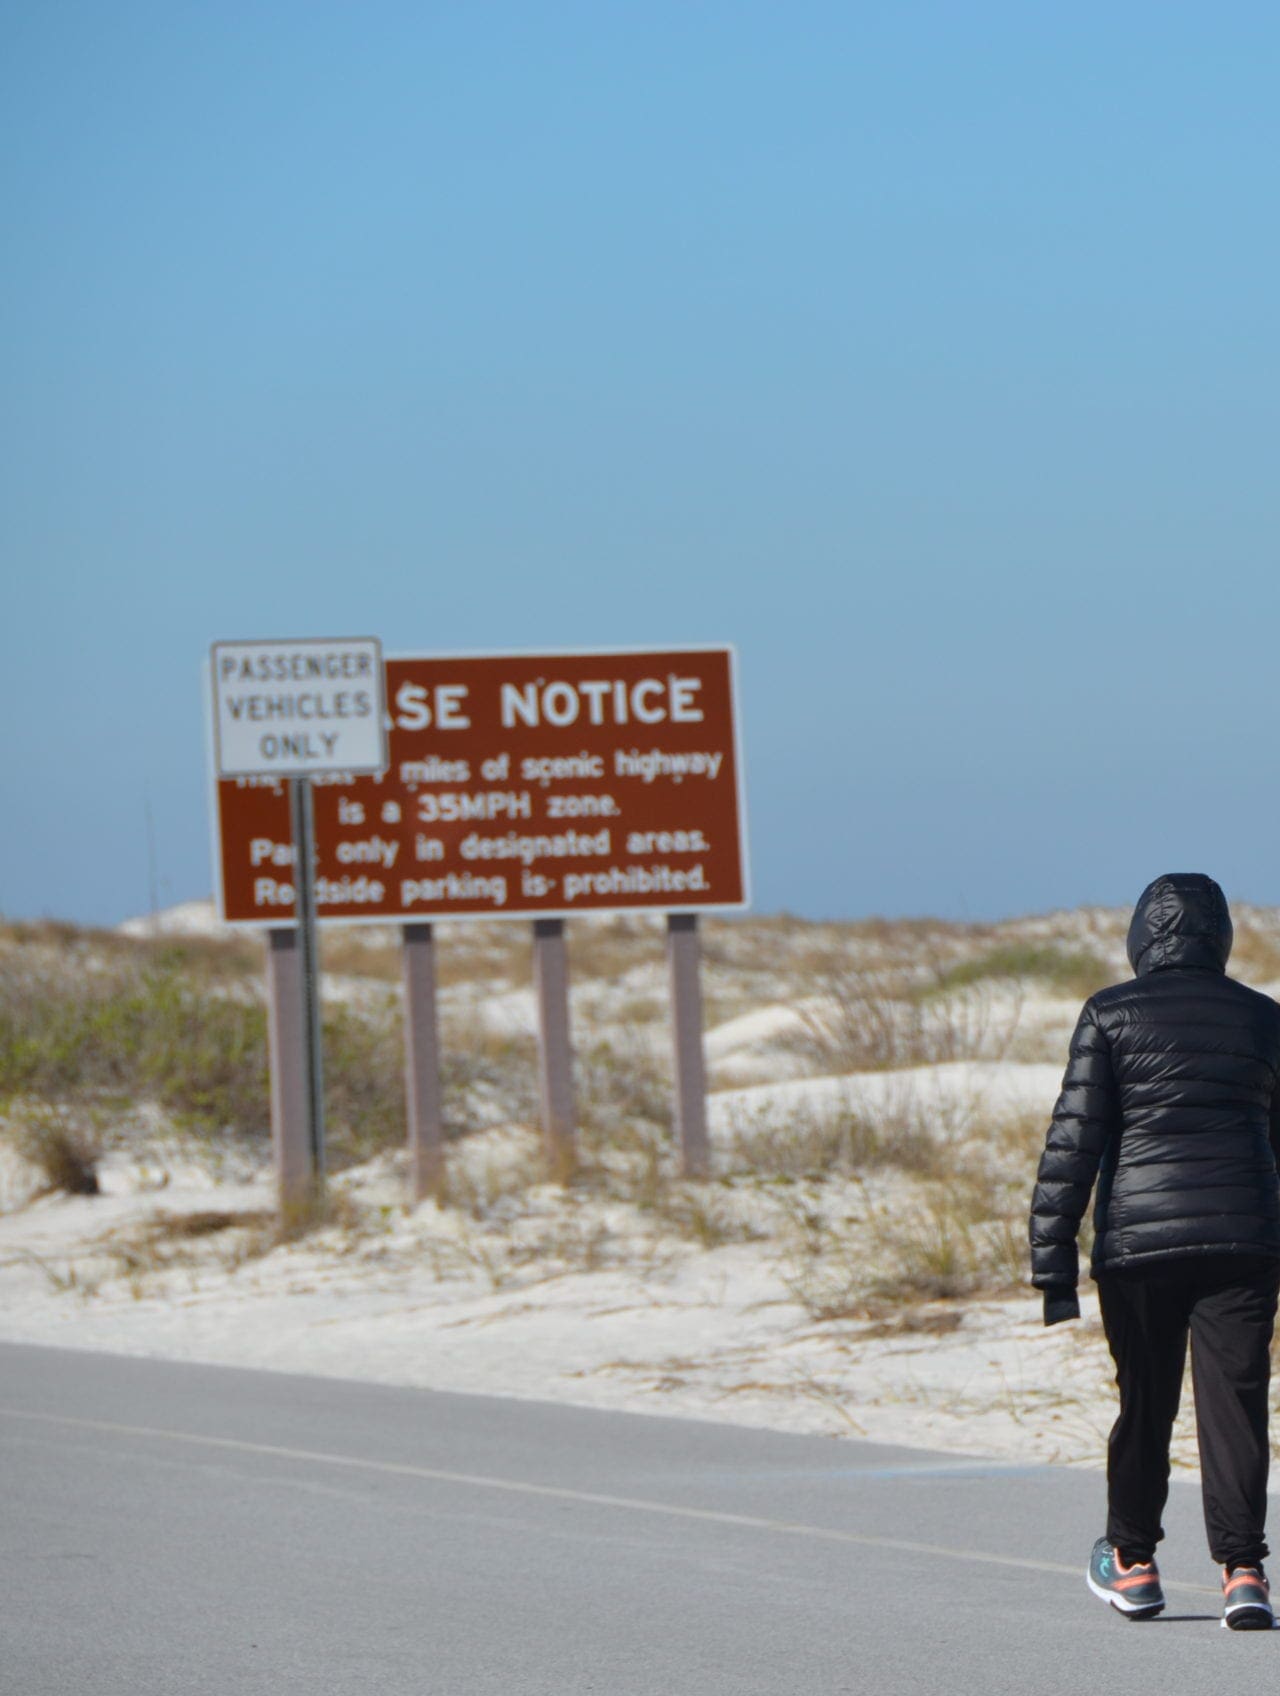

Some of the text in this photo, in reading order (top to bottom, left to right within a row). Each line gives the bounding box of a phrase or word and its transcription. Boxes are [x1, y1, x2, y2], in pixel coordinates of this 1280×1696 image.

[220, 653, 372, 683] PASSENGER
[225, 690, 373, 721] VEHICLES
[384, 675, 704, 732] SE NOTICE
[259, 731, 339, 760] ONLY
[400, 754, 470, 783] miles
[480, 752, 511, 781] of
[520, 753, 605, 781] scenic
[614, 748, 724, 784] highway
[338, 797, 366, 825] is
[381, 800, 402, 824] a
[417, 791, 531, 822] 35MPH
[335, 835, 400, 869] only
[415, 833, 445, 861] in
[459, 829, 611, 866] designated
[254, 874, 386, 906] Rodside
[400, 872, 508, 908] parking
